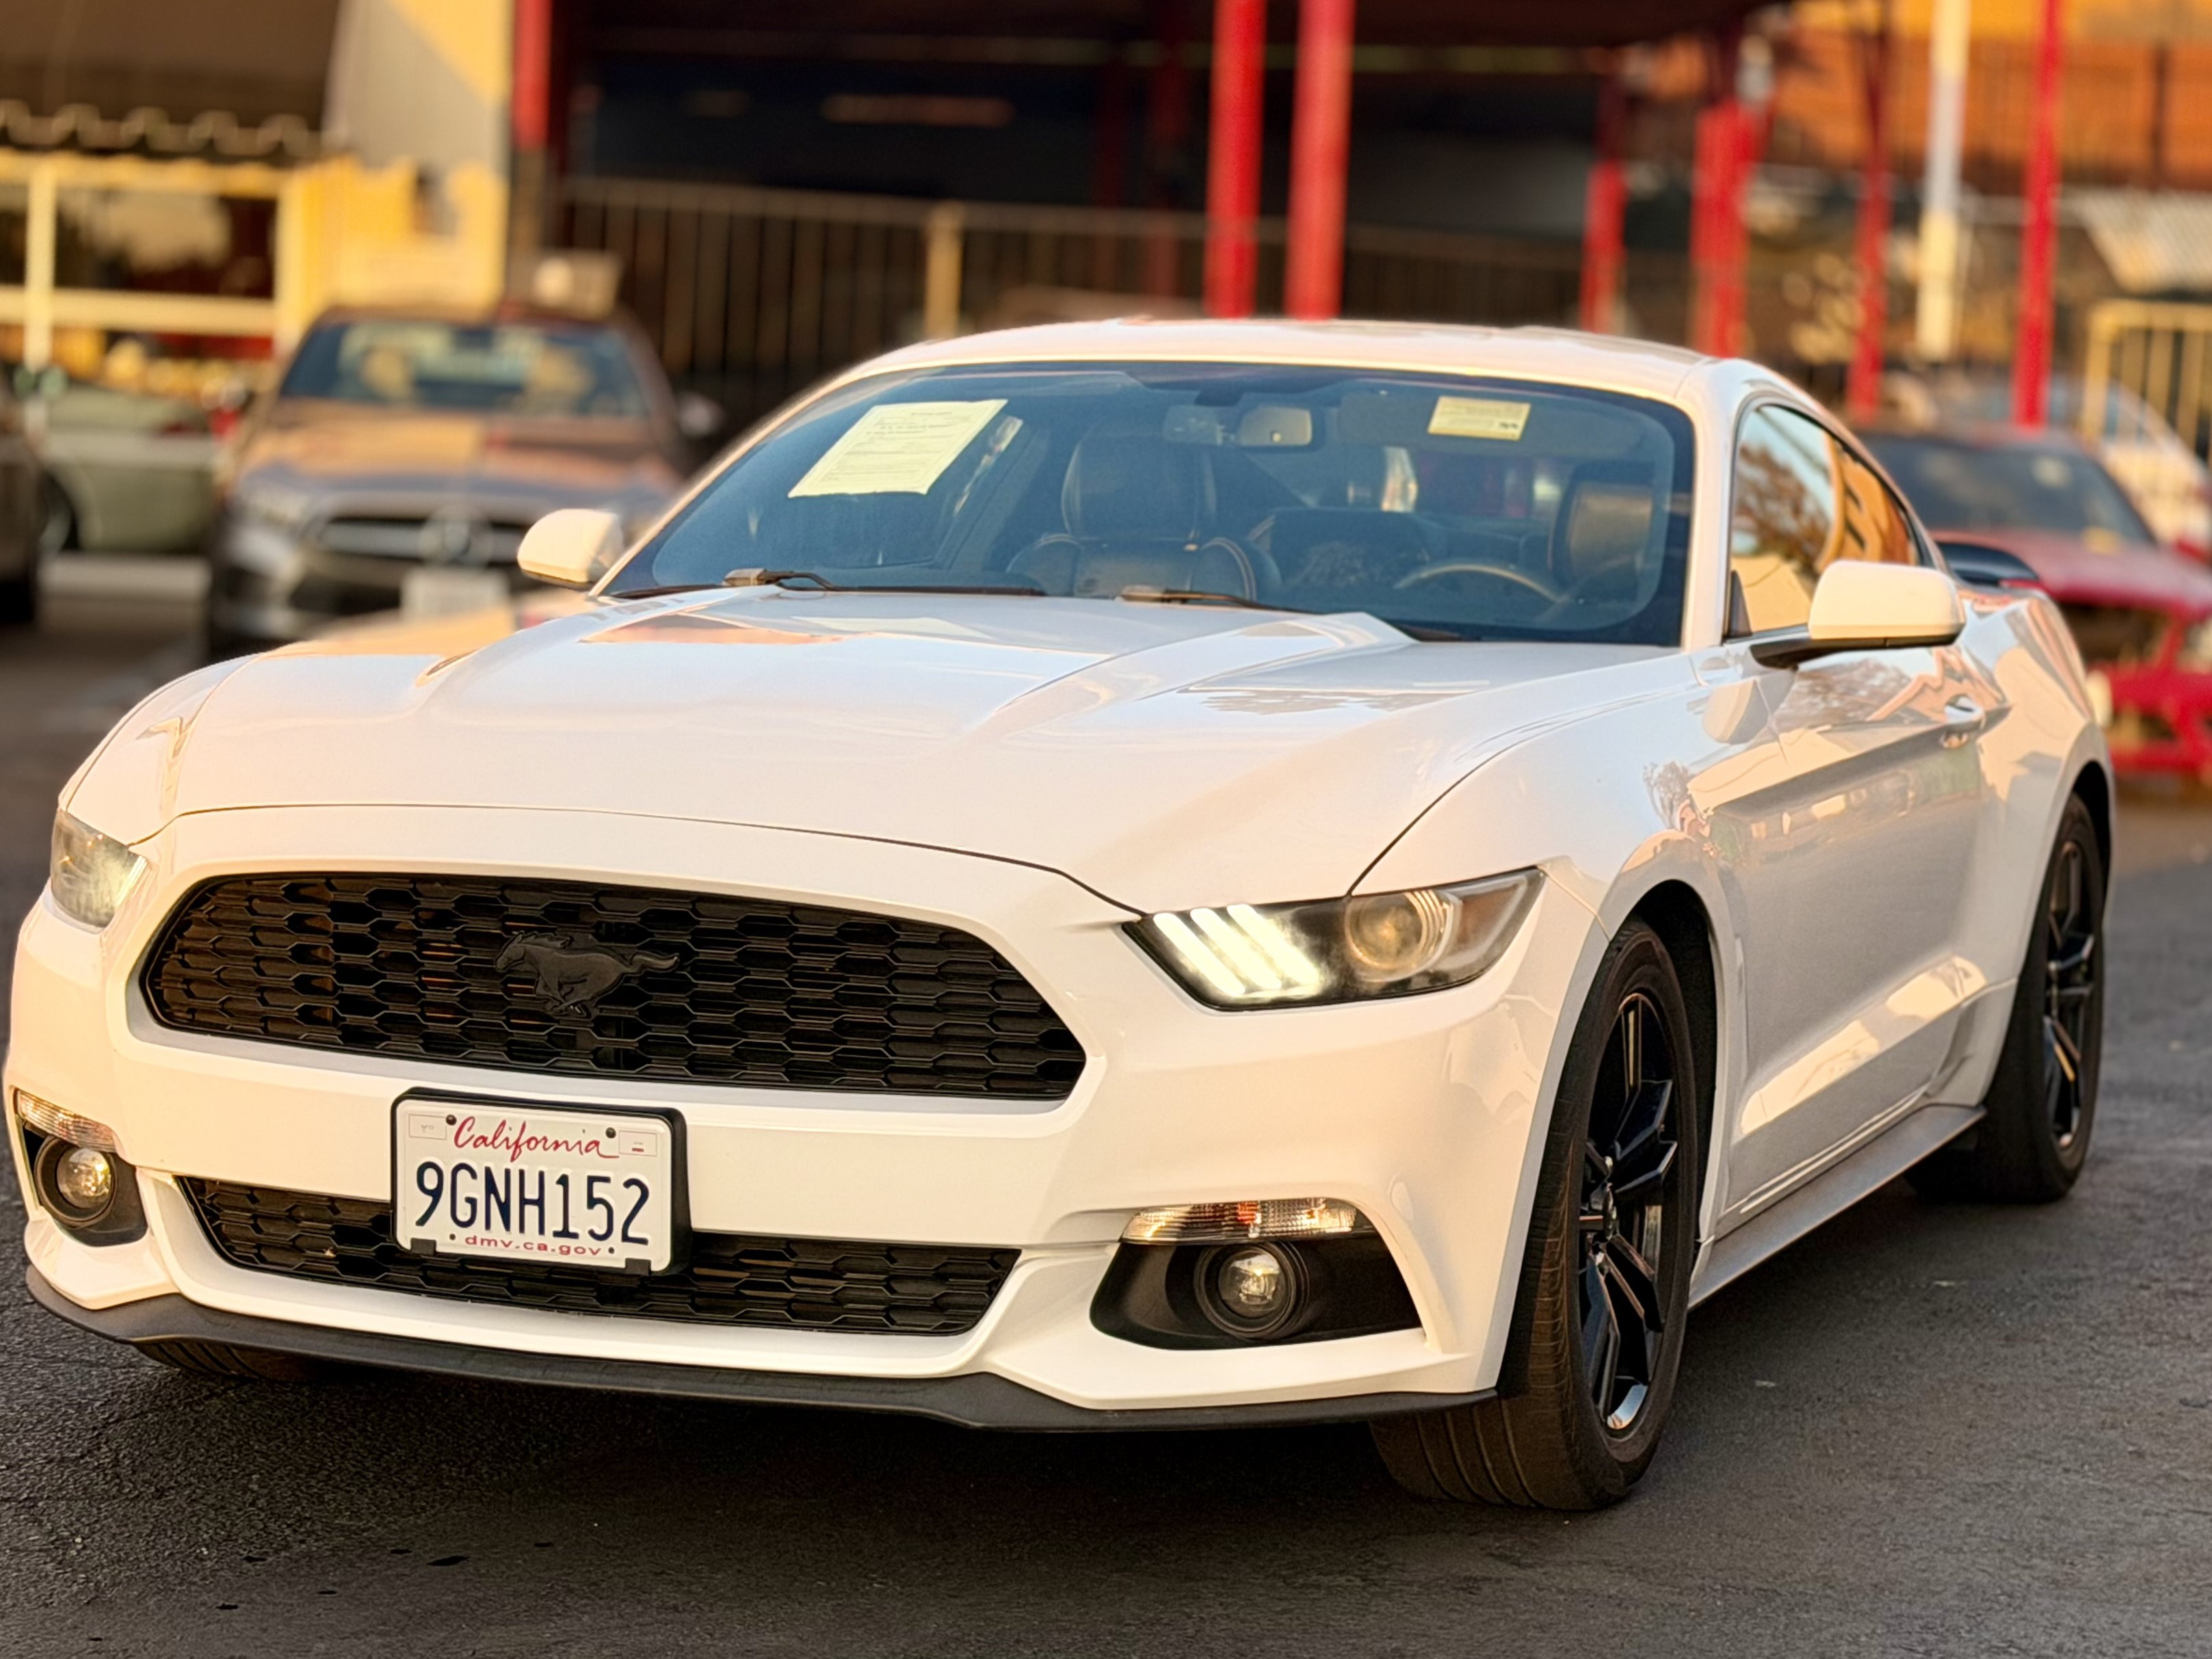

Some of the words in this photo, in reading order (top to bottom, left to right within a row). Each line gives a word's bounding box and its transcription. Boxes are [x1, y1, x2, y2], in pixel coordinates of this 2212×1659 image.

[453, 1116, 620, 1163] California
[415, 1160, 649, 1245] 9GNH152
[464, 1235, 602, 1256] dmv.ca.gov
